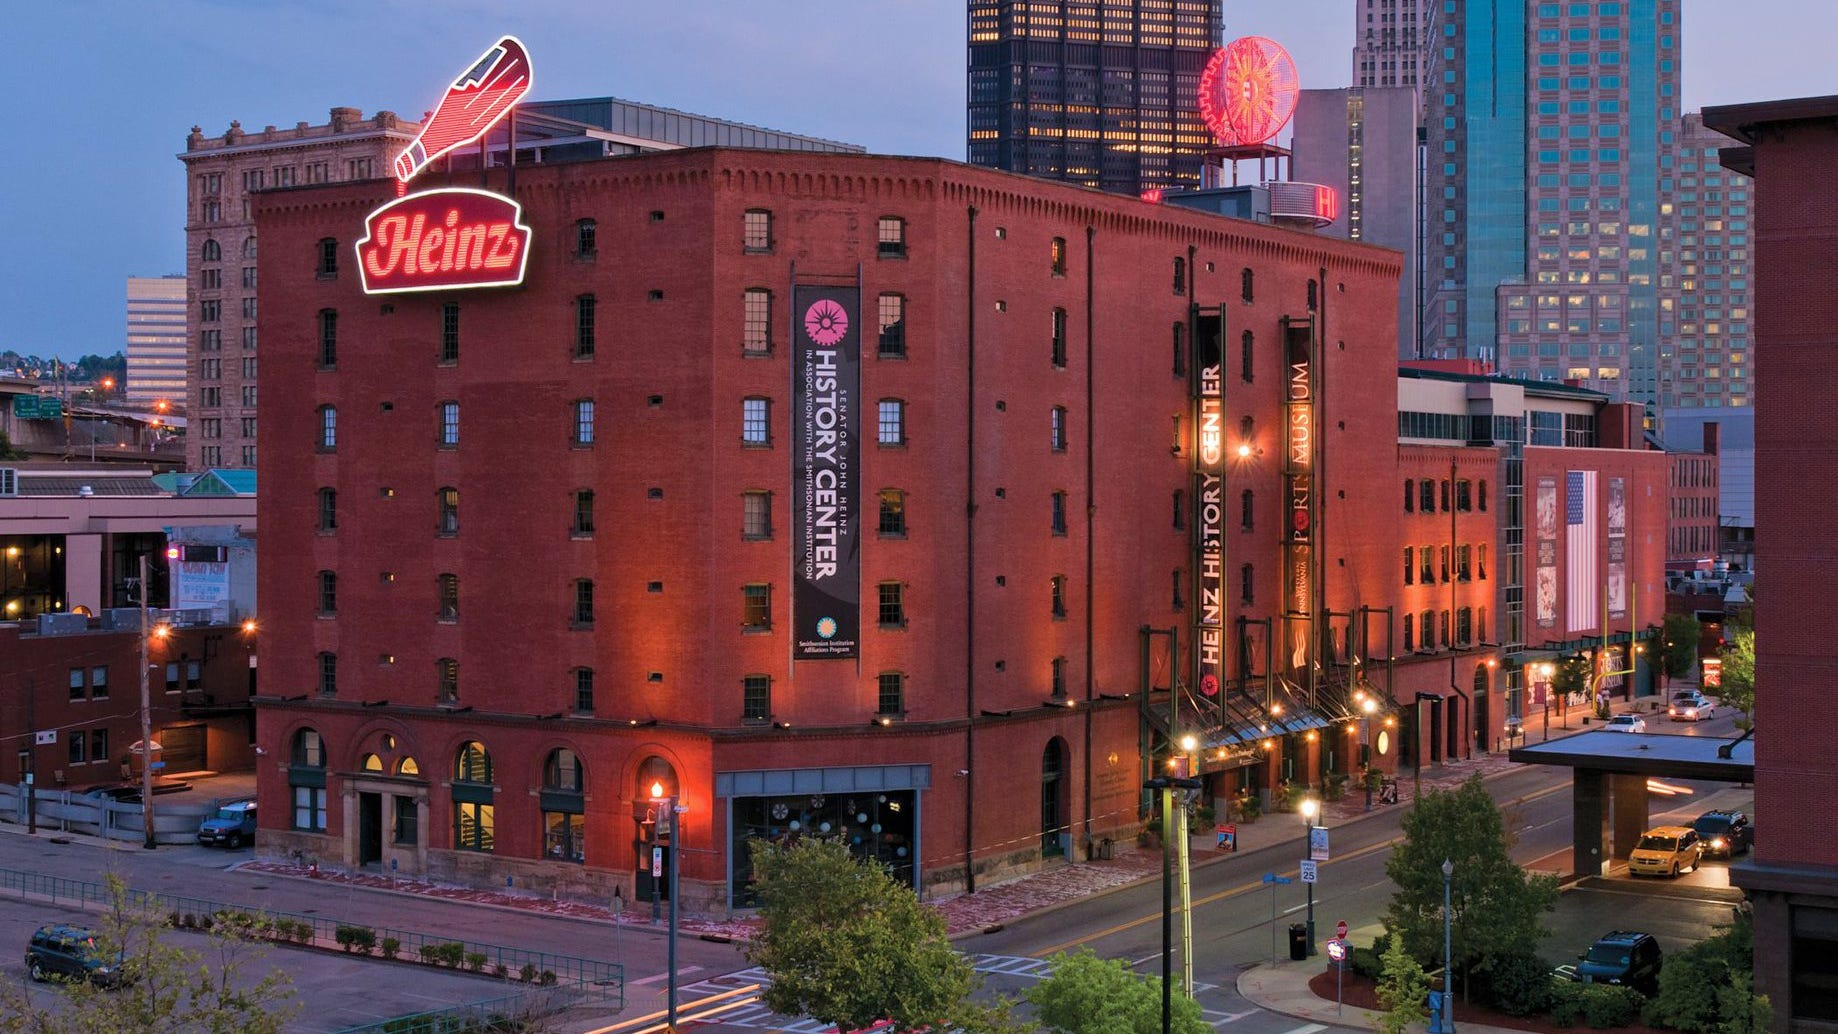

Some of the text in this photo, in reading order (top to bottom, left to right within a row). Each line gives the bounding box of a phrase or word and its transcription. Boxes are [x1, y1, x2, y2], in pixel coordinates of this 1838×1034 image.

[366, 210, 519, 276] Heinz
[1202, 363, 1221, 465] CENTER
[805, 350, 813, 580] IN ASSOCIATION WITH THE SMITHSONIAN INSTITUTION
[815, 350, 837, 580] HISTORY CENTER
[839, 390, 847, 535] SENATOR JOHN HEINZ
[829, 646, 850, 654] Program
[1202, 587, 1220, 664] HENZ
[1303, 872, 1315, 880] 25
